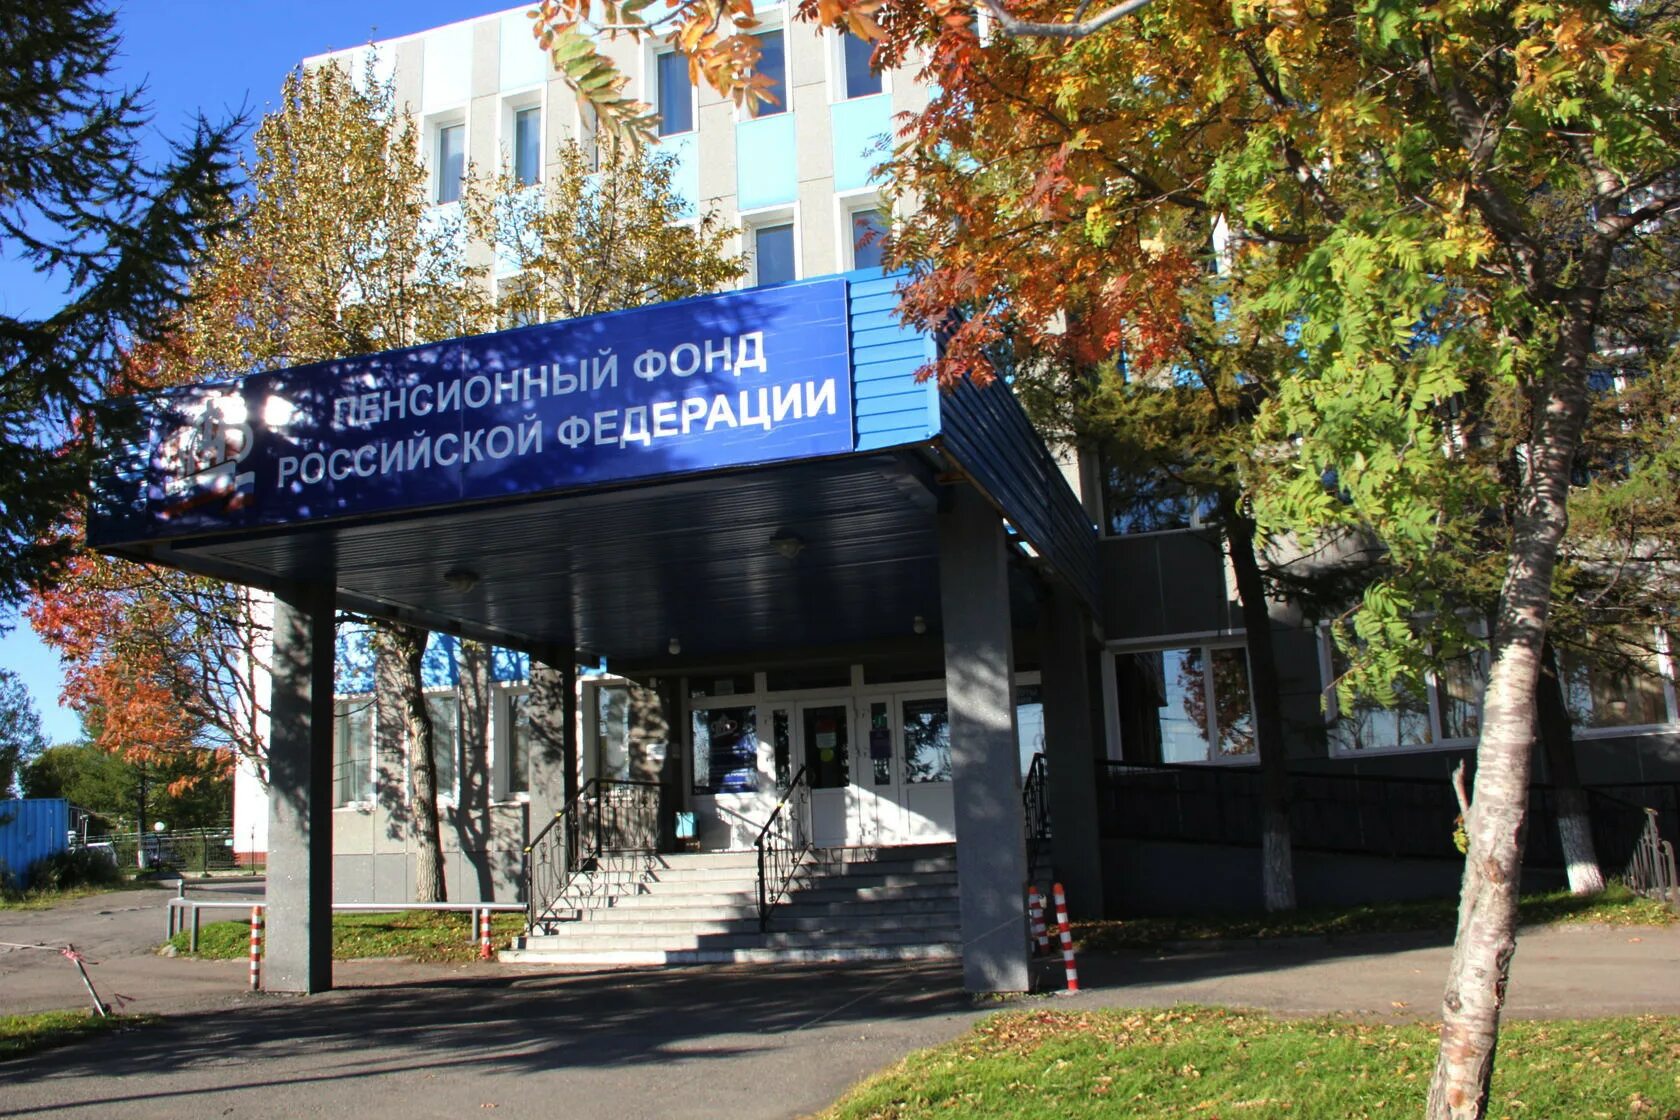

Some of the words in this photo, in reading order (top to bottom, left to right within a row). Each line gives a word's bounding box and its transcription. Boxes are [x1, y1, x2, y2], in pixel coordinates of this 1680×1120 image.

[333, 347, 618, 428] ПЕНСИОННЫЙ
[633, 331, 767, 382] ФОНД
[277, 413, 543, 489] РОССИЙСКОЙ
[557, 379, 836, 449] ФЕДЕРАЦИИ
